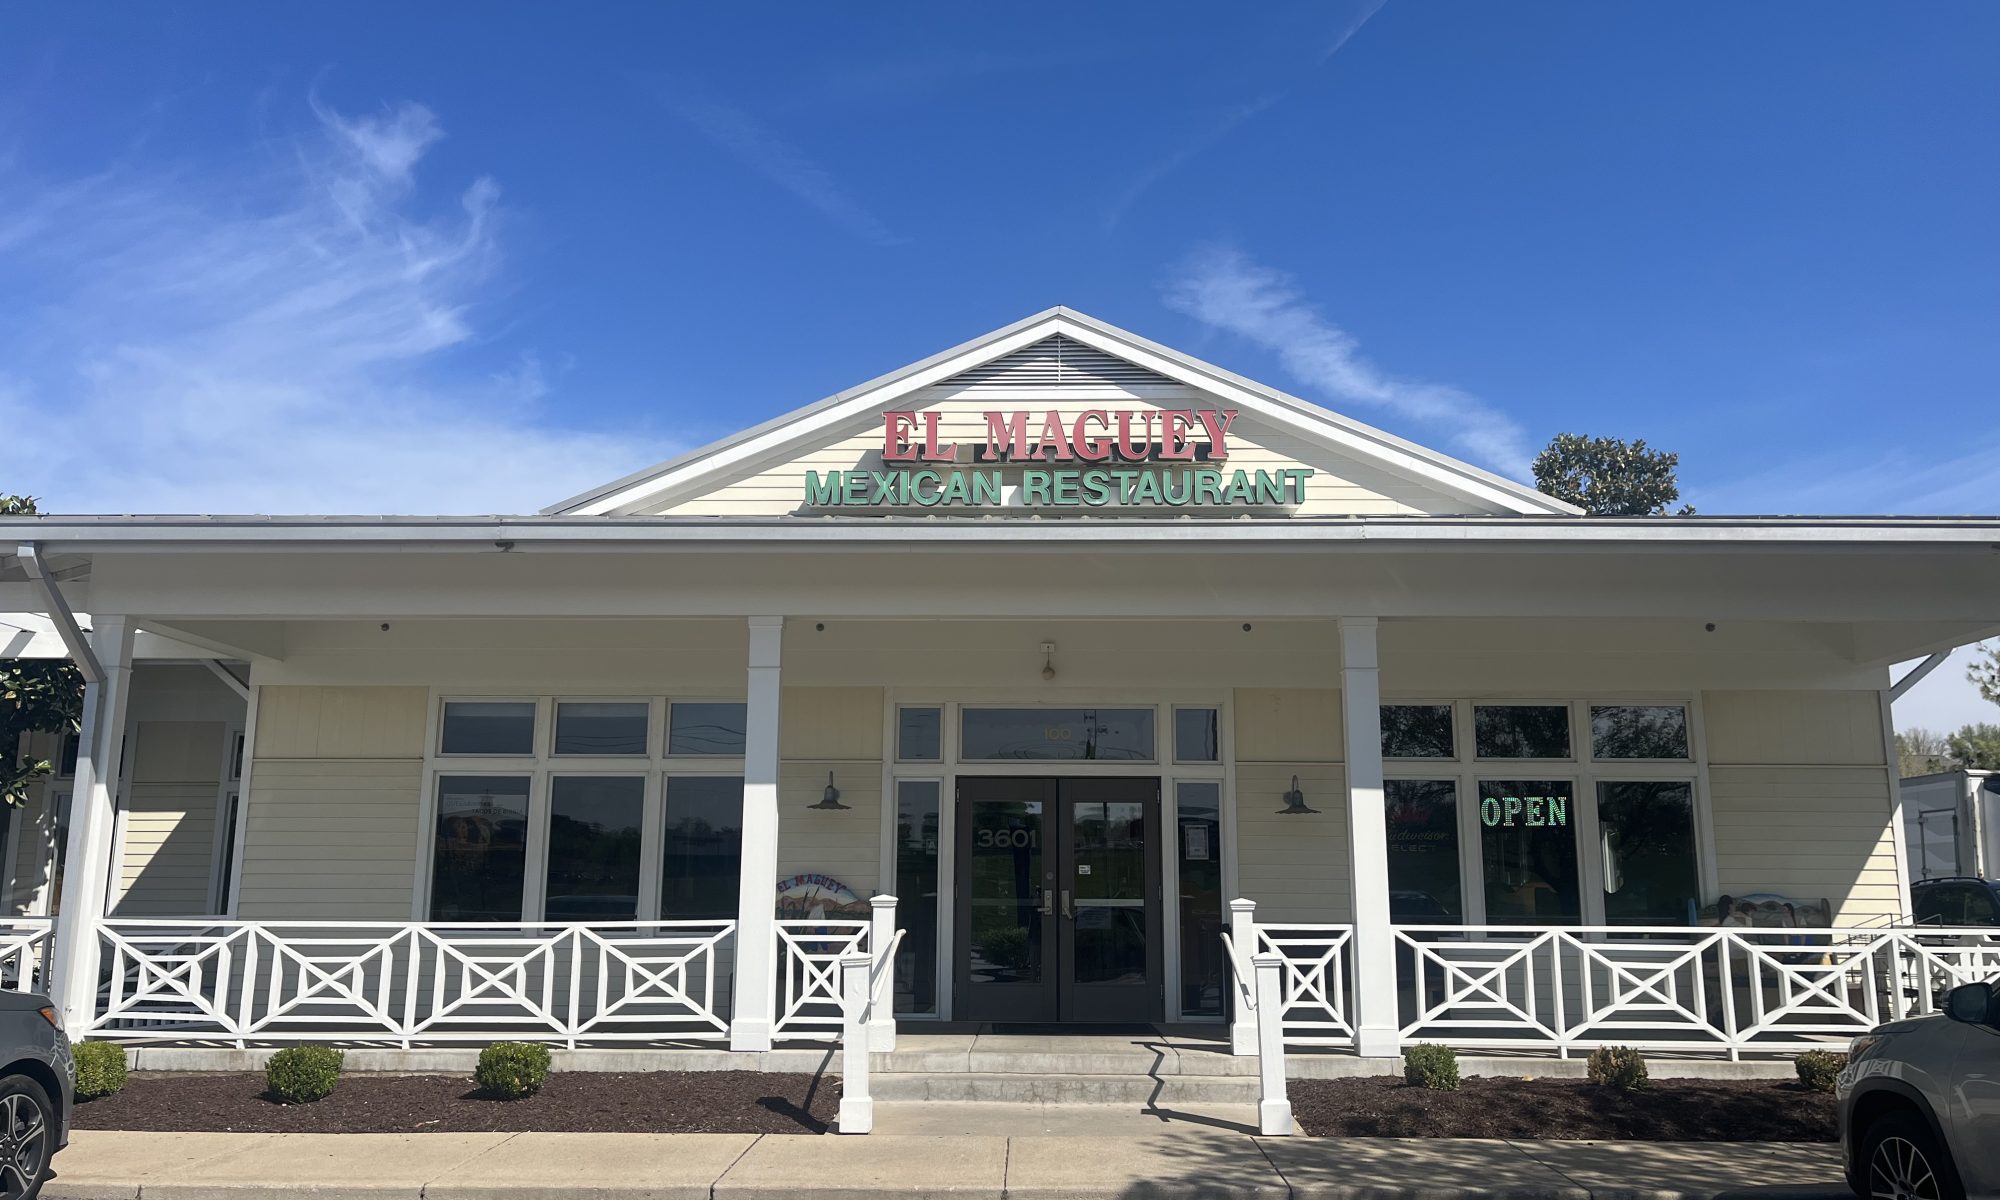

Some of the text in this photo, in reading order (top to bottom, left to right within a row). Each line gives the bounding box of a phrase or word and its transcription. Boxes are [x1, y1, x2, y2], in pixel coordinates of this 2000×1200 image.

[881, 409, 1239, 463] EL MAGUEY
[804, 469, 1315, 506] MEXICAN RESTAURANT
[1045, 727, 1072, 740] 100
[1481, 797, 1567, 827] OPEN
[928, 841, 936, 849] A
[977, 829, 1036, 848] 3601
[776, 873, 848, 894] EL MAGUEY
